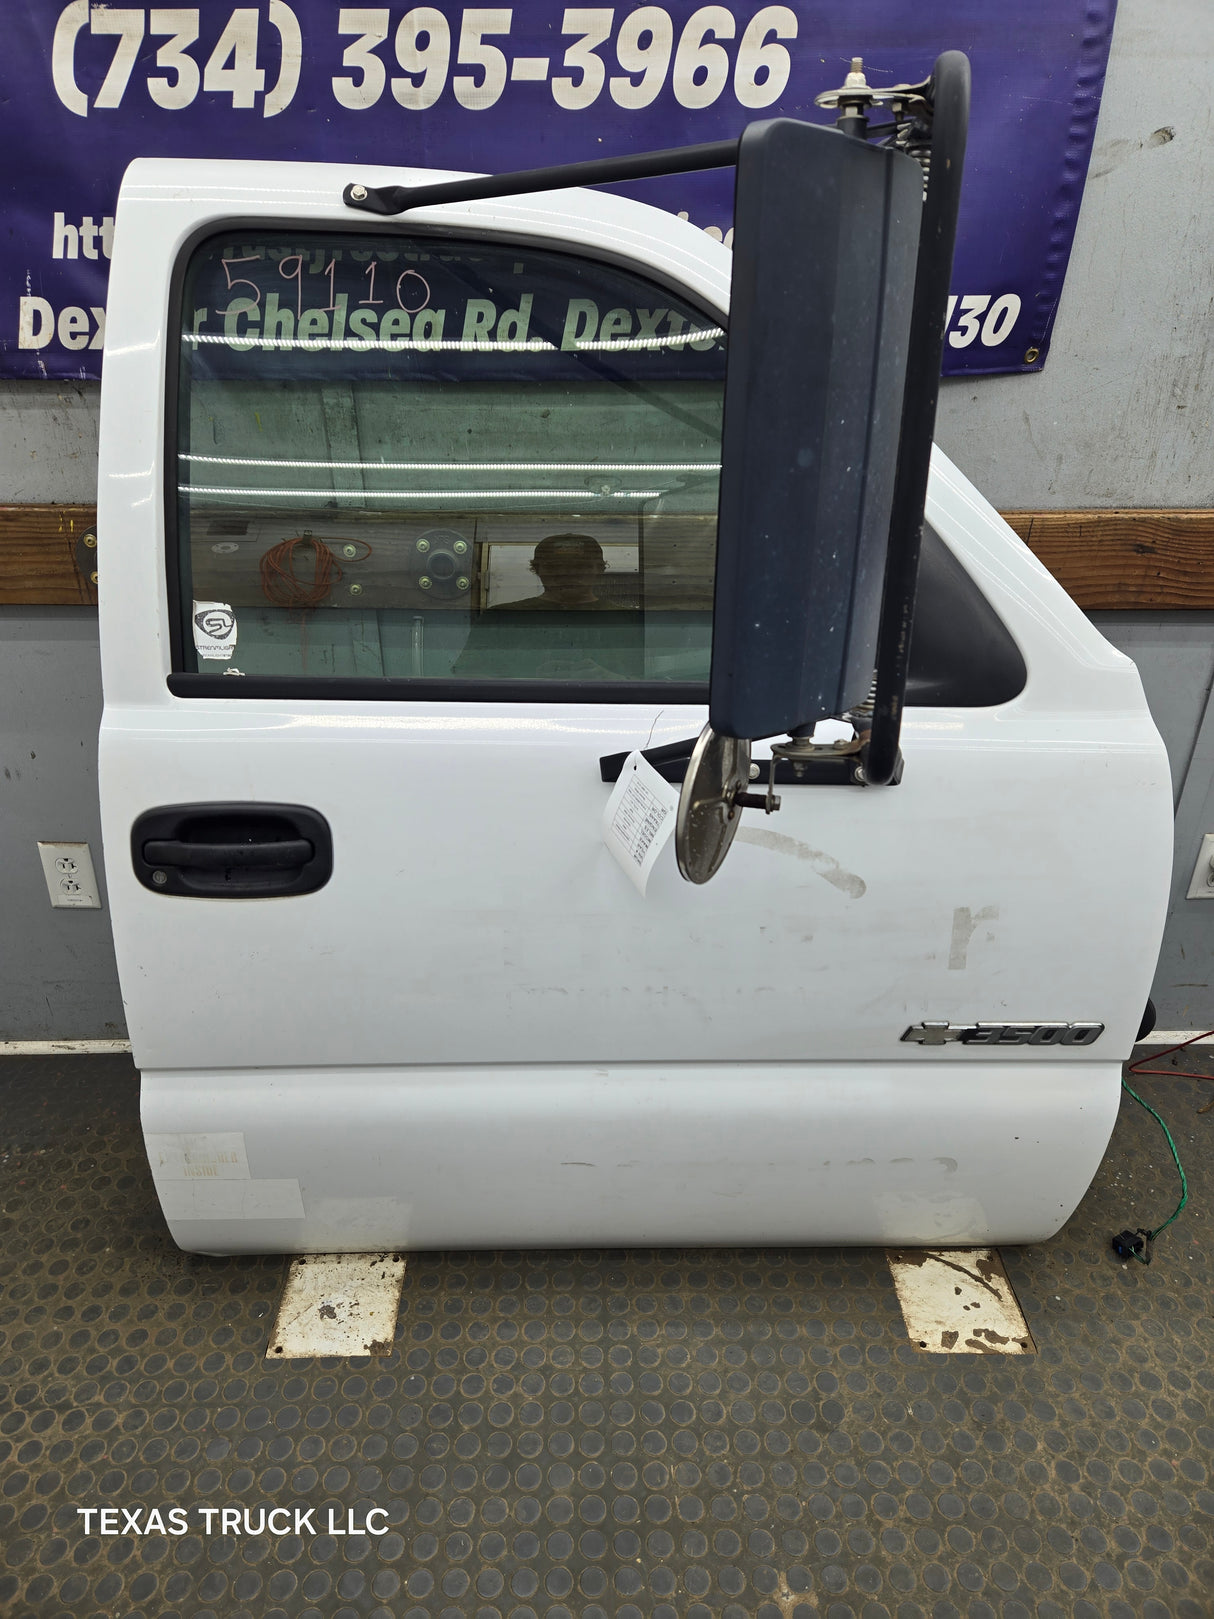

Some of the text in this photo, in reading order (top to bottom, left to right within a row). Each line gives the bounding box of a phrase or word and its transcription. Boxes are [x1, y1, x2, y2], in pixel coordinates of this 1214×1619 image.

[52, 0, 799, 118] (734) 395-3966
[215, 254, 431, 321] 59110
[223, 292, 447, 352] Chelsea
[460, 292, 544, 352] Rd.
[964, 1021, 1105, 1046] 3500
